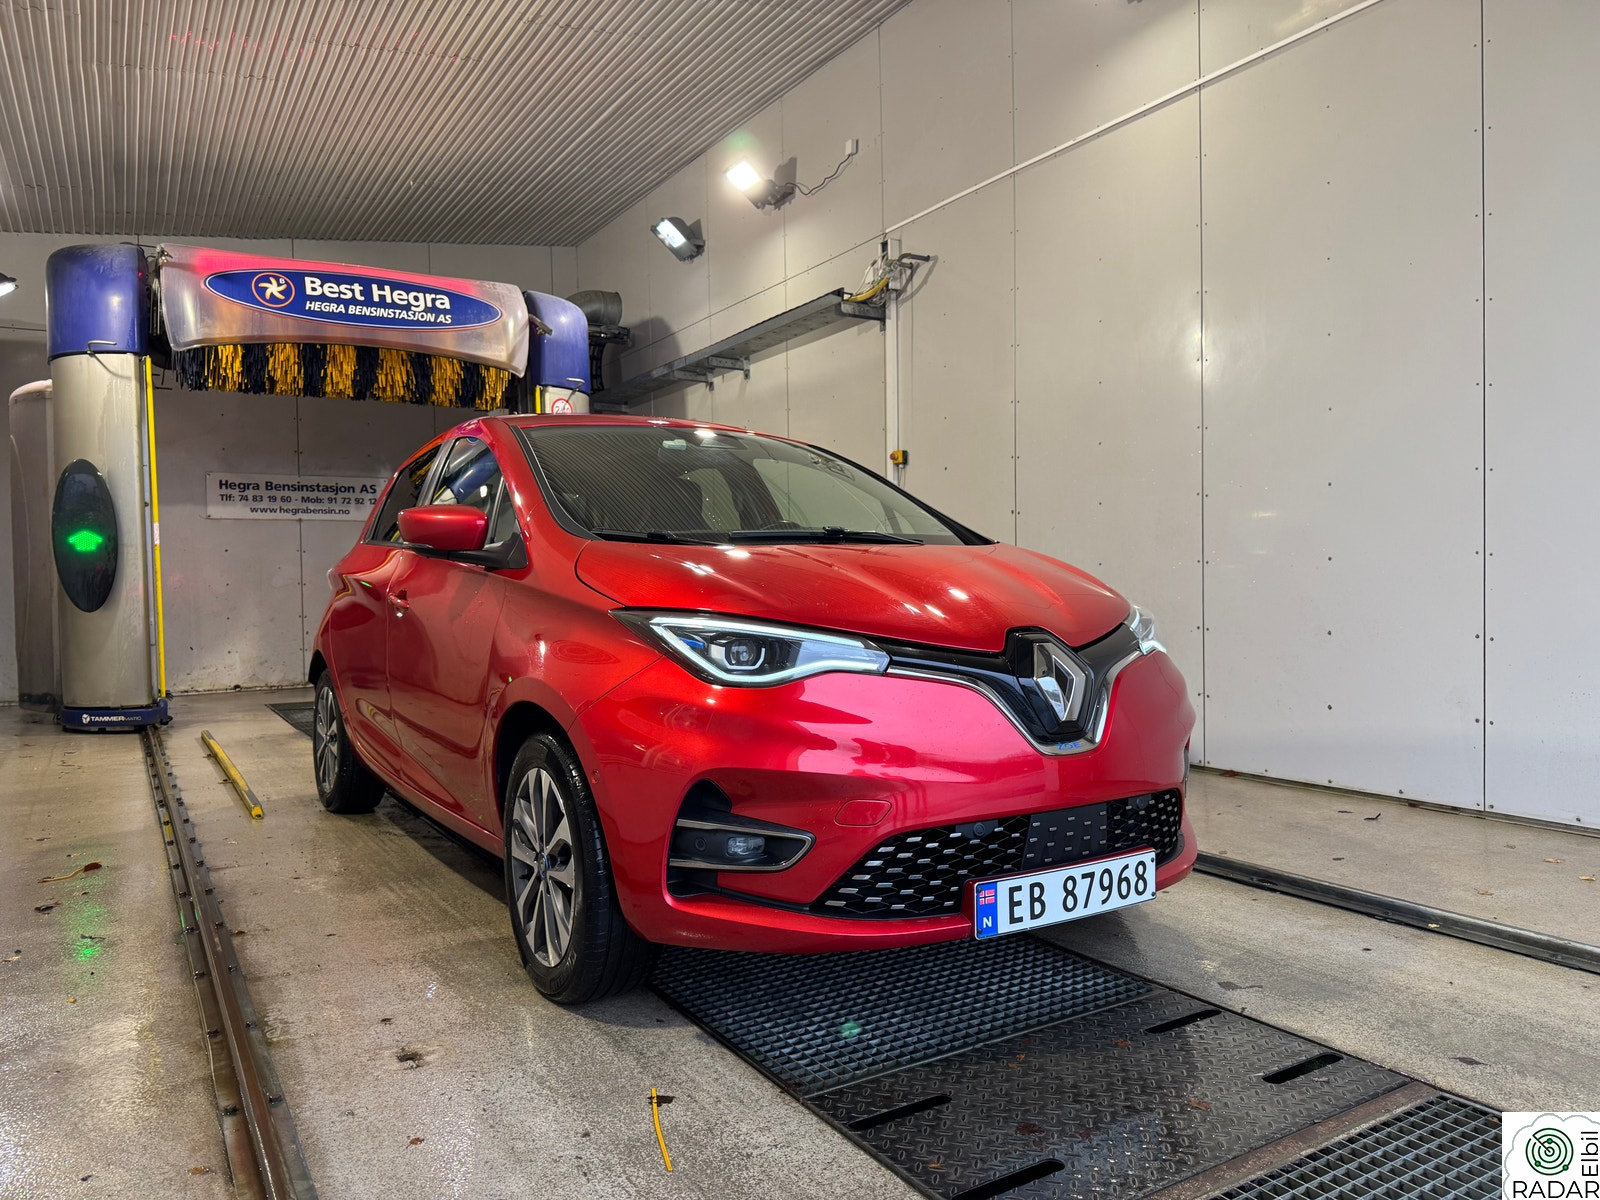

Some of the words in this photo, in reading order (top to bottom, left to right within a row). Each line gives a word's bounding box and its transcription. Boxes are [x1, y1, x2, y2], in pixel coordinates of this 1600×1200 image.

[304, 276, 365, 301] Best
[371, 283, 451, 312] Hegra
[305, 300, 346, 314] HEGRA
[348, 305, 435, 323] BENSINSTASJON
[437, 314, 452, 324] AS
[218, 479, 260, 493] Hegra
[265, 481, 355, 495] Bensinstasjon
[360, 484, 377, 494] AS
[220, 494, 235, 502] Tlf:
[238, 494, 249, 502] 74
[252, 495, 263, 503] 83
[301, 496, 325, 504] Mob:
[1008, 881, 1046, 924] EB
[1062, 860, 1148, 913] 87968
[982, 916, 992, 928] N
